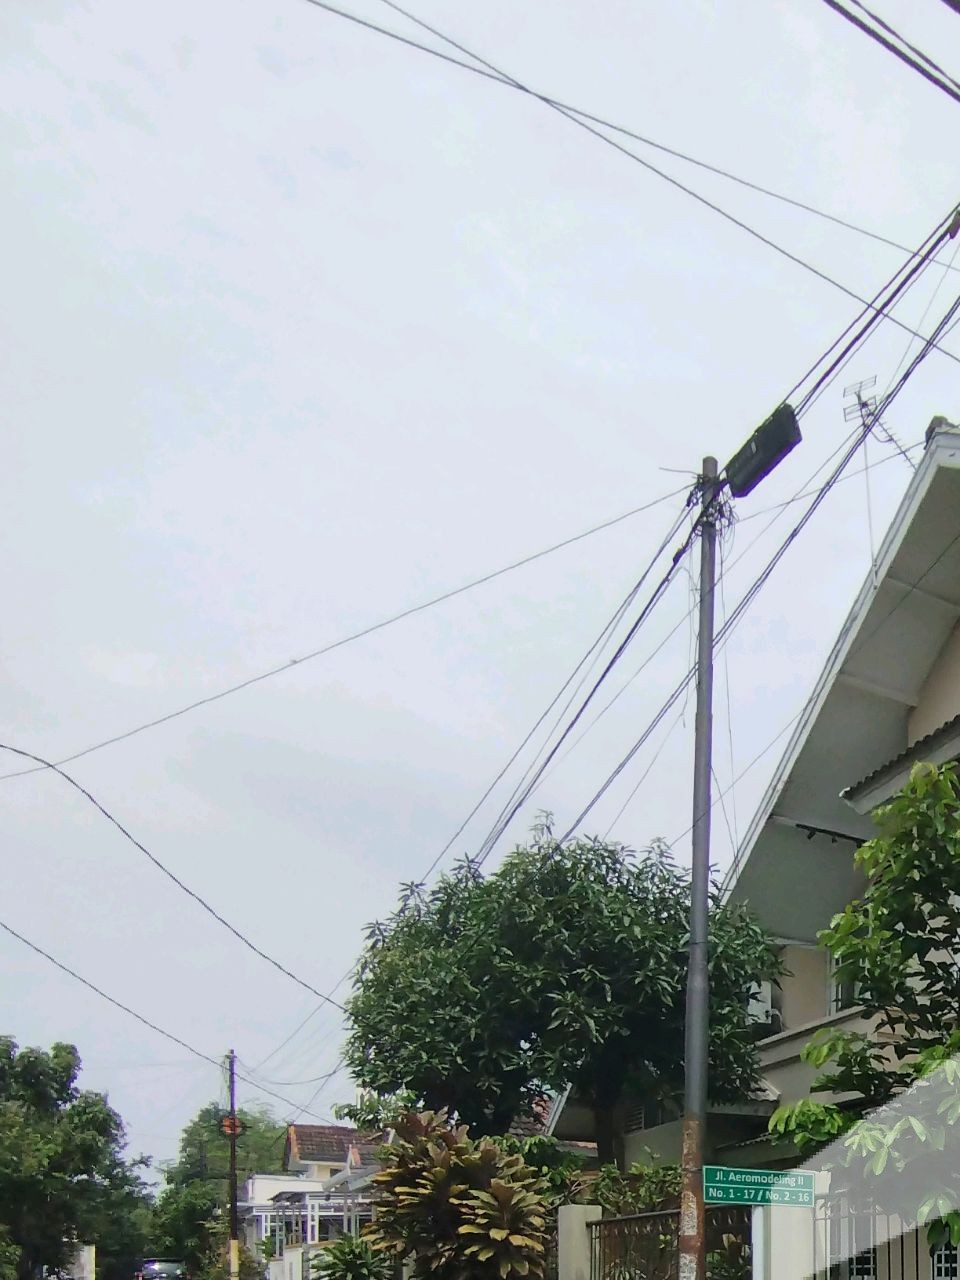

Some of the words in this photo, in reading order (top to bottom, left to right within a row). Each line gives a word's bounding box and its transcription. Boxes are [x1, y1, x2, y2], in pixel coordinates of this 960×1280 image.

[715, 1170, 726, 1180] Jl.
[728, 1171, 796, 1186] Aeromodeling
[797, 1175, 804, 1185] II
[708, 1187, 726, 1197] No.
[729, 1188, 735, 1198] 1
[743, 1189, 755, 1199] 17
[757, 1189, 764, 1201] /
[765, 1190, 782, 1201] No.
[784, 1191, 790, 1201] 2
[798, 1192, 810, 1202] 16
